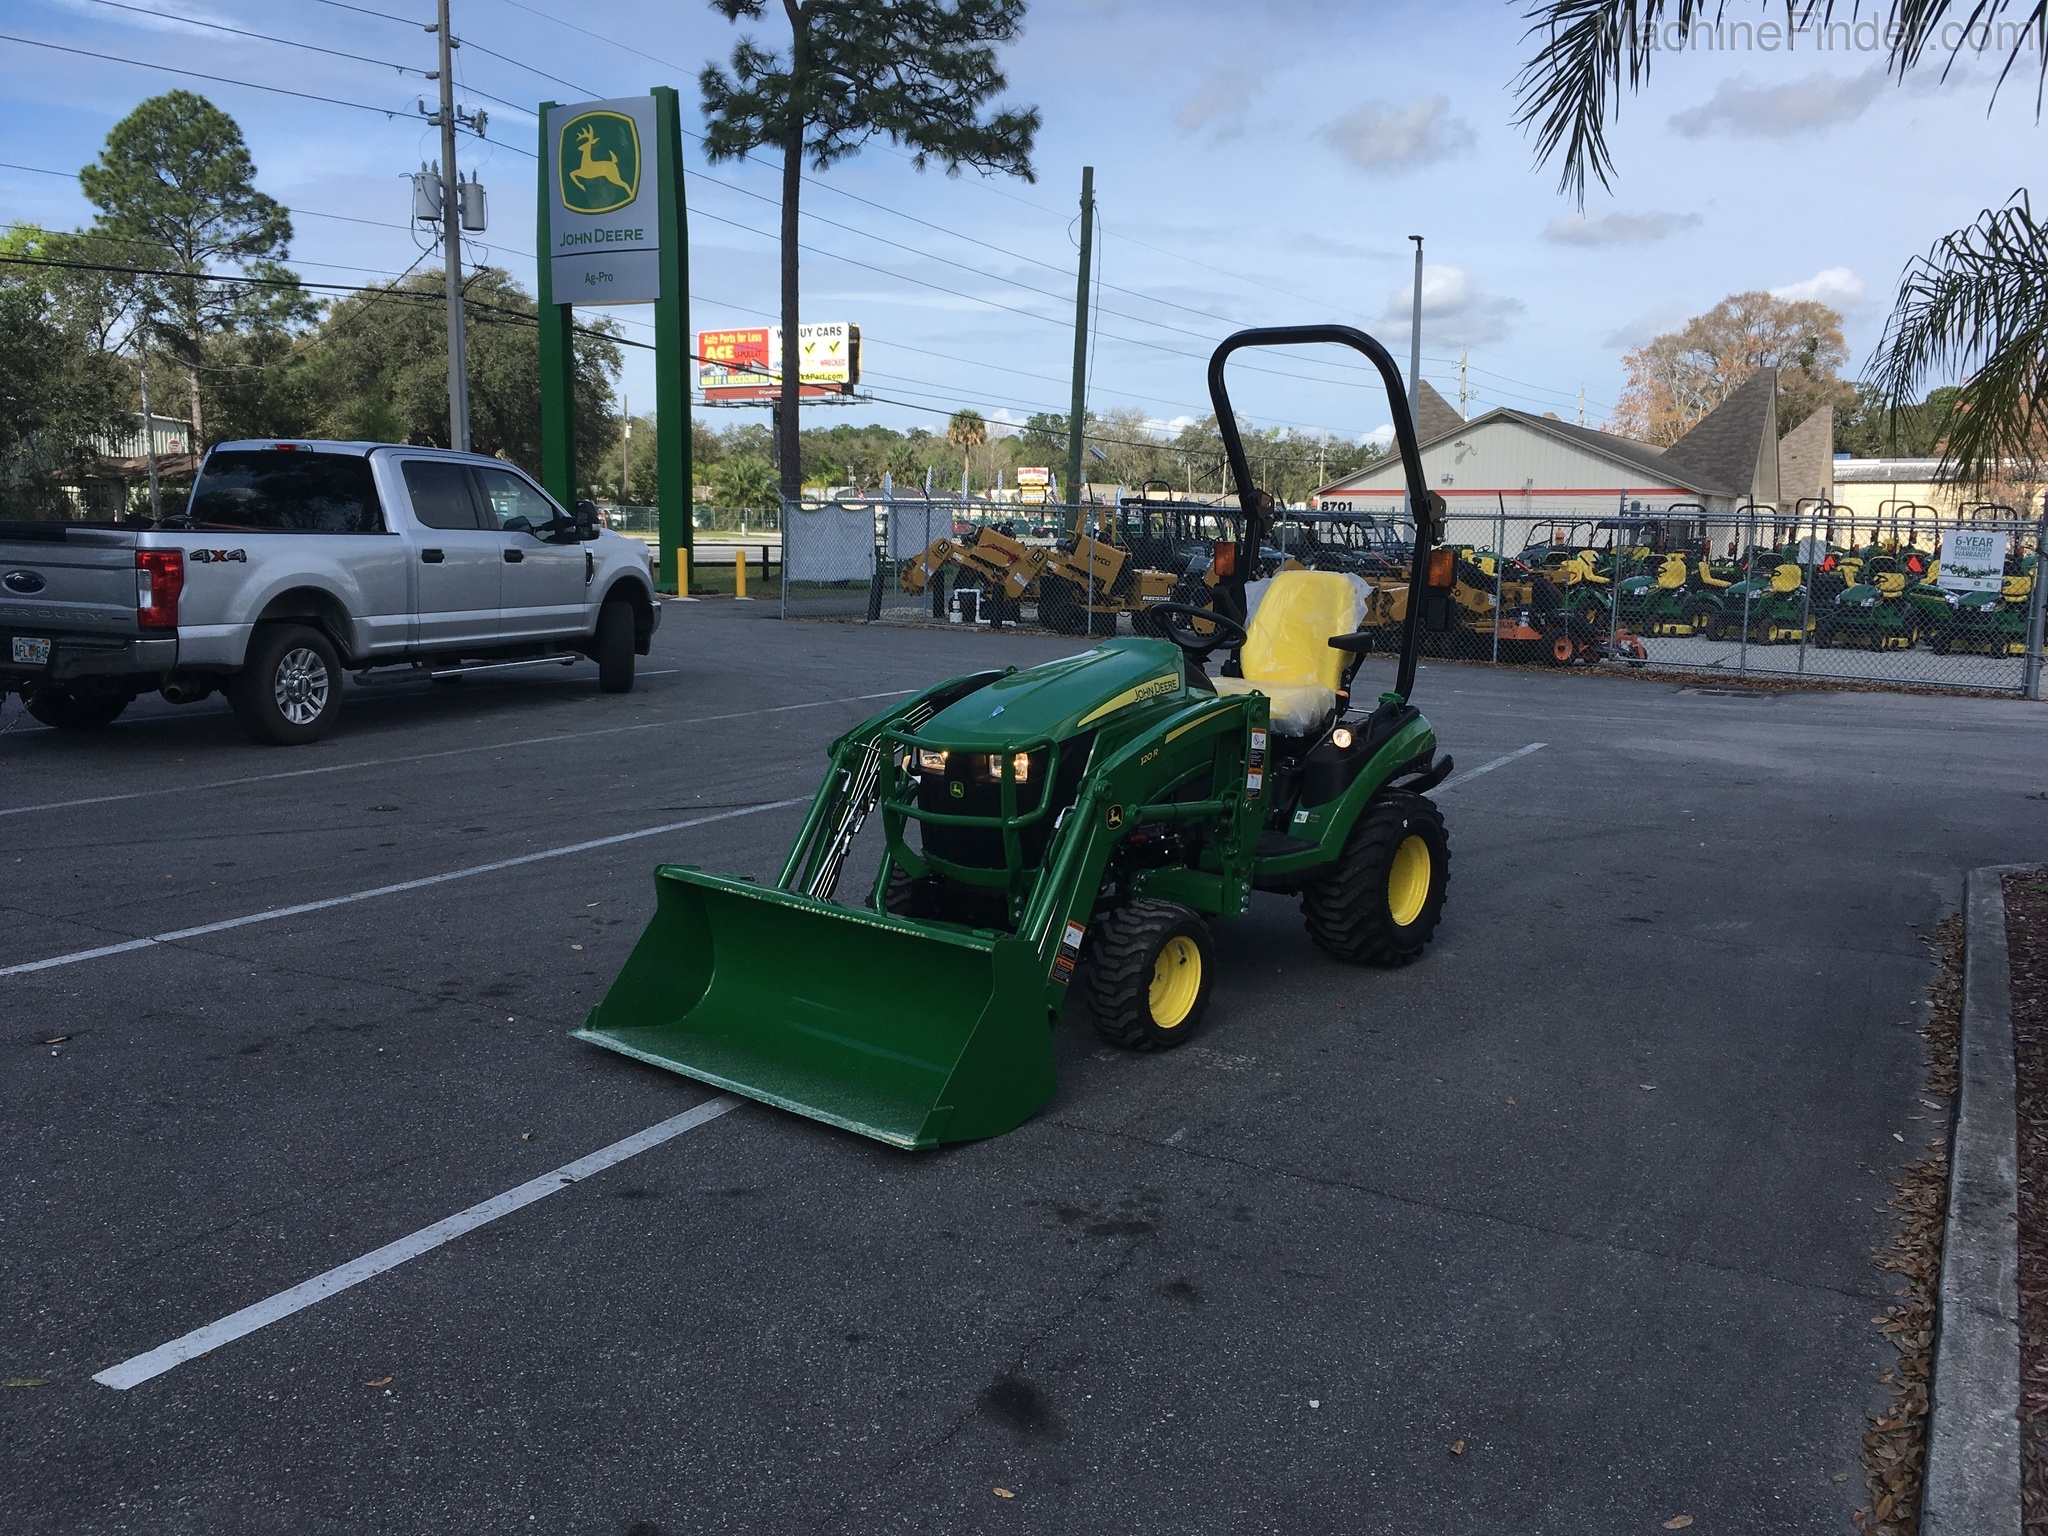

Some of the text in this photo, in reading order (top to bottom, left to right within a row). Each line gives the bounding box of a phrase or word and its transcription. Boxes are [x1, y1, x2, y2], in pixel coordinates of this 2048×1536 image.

[560, 228, 644, 247] JOHN DEERE
[584, 271, 614, 285] Ag-Pro
[816, 326, 842, 337] CARS
[704, 332, 763, 345] Auto Parts for Less
[705, 345, 734, 360] ACE
[820, 359, 846, 367] WRECKED
[1321, 501, 1353, 511] 8701
[1955, 535, 1994, 548] 6-YEAR
[1134, 679, 1177, 701] JOHN DEERE
